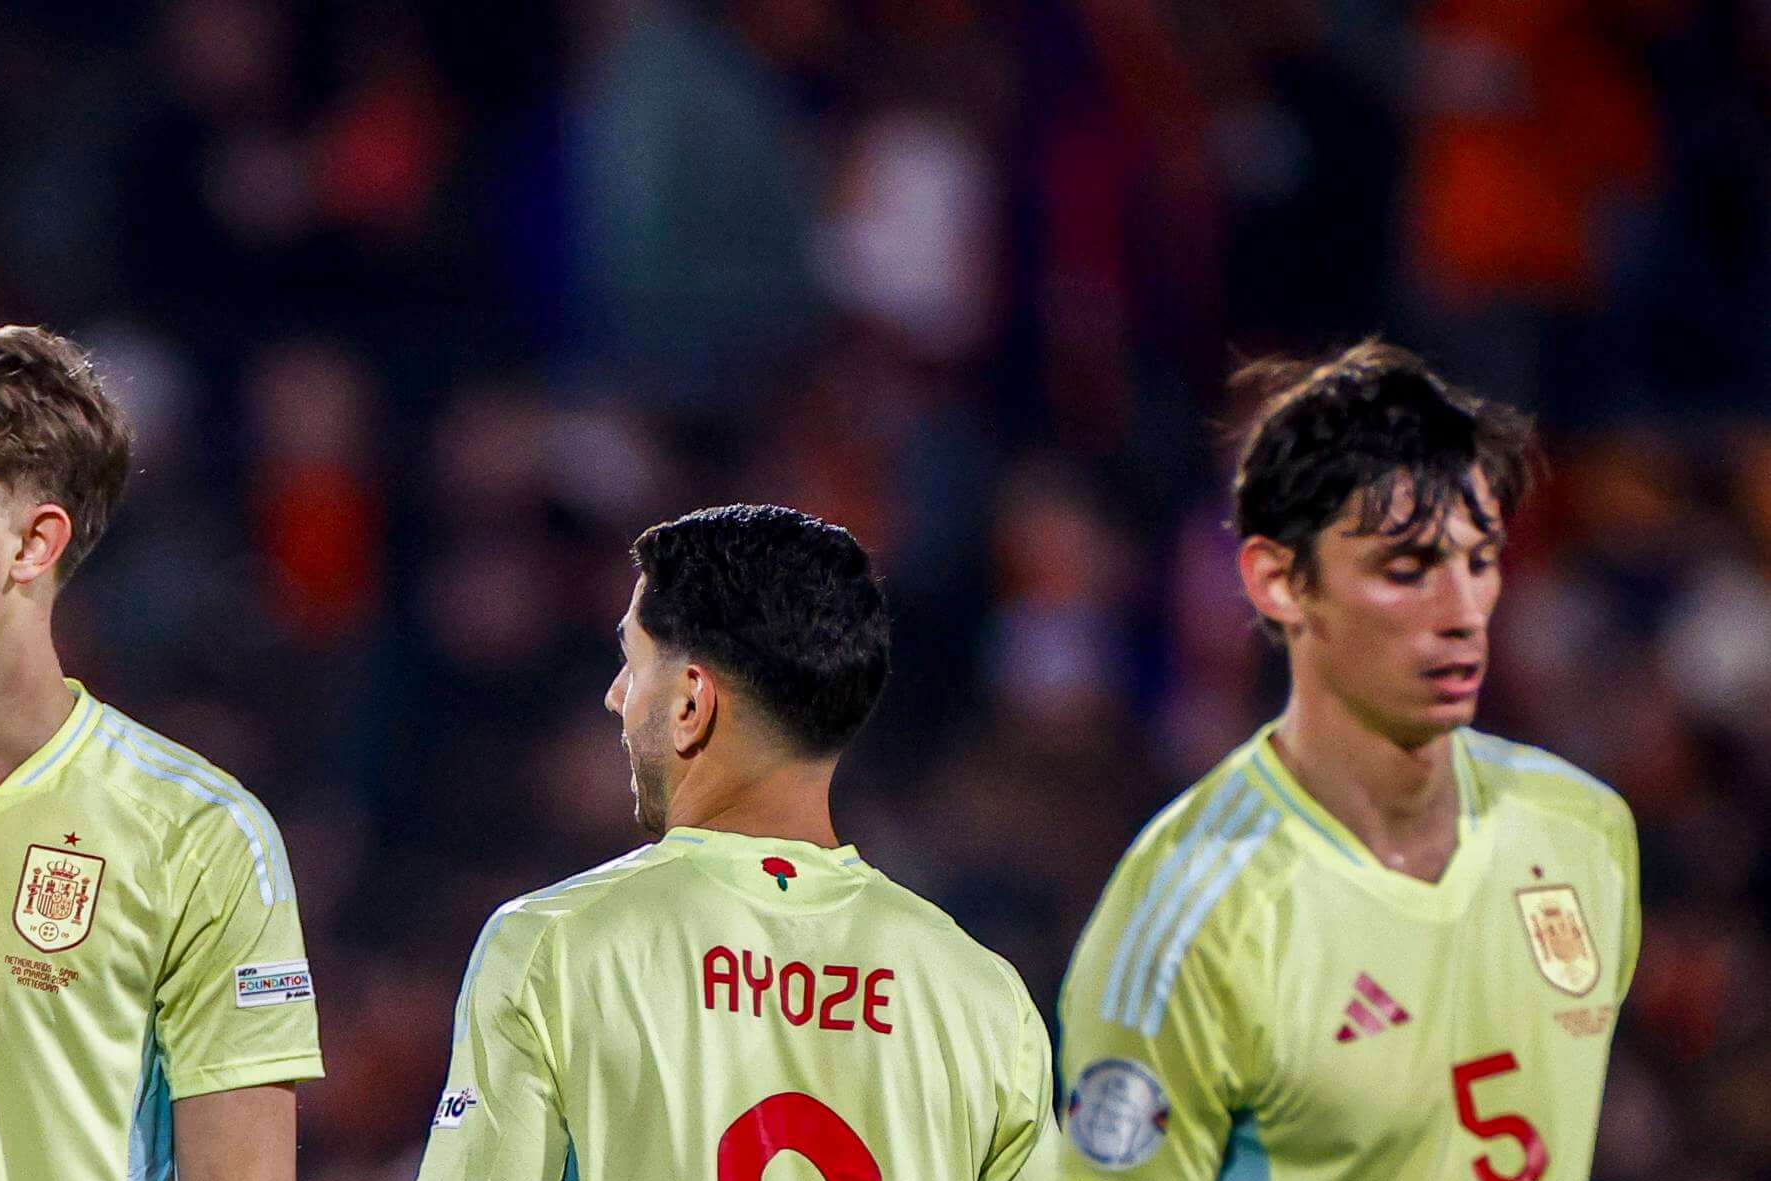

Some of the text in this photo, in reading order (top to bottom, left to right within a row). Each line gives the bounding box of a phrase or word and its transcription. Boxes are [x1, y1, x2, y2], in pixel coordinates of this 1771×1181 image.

[11, 965, 21, 975] 20
[58, 967, 79, 981] SPAIN
[238, 975, 309, 992] FOUNDATION
[703, 945, 894, 1035] AYOZE
